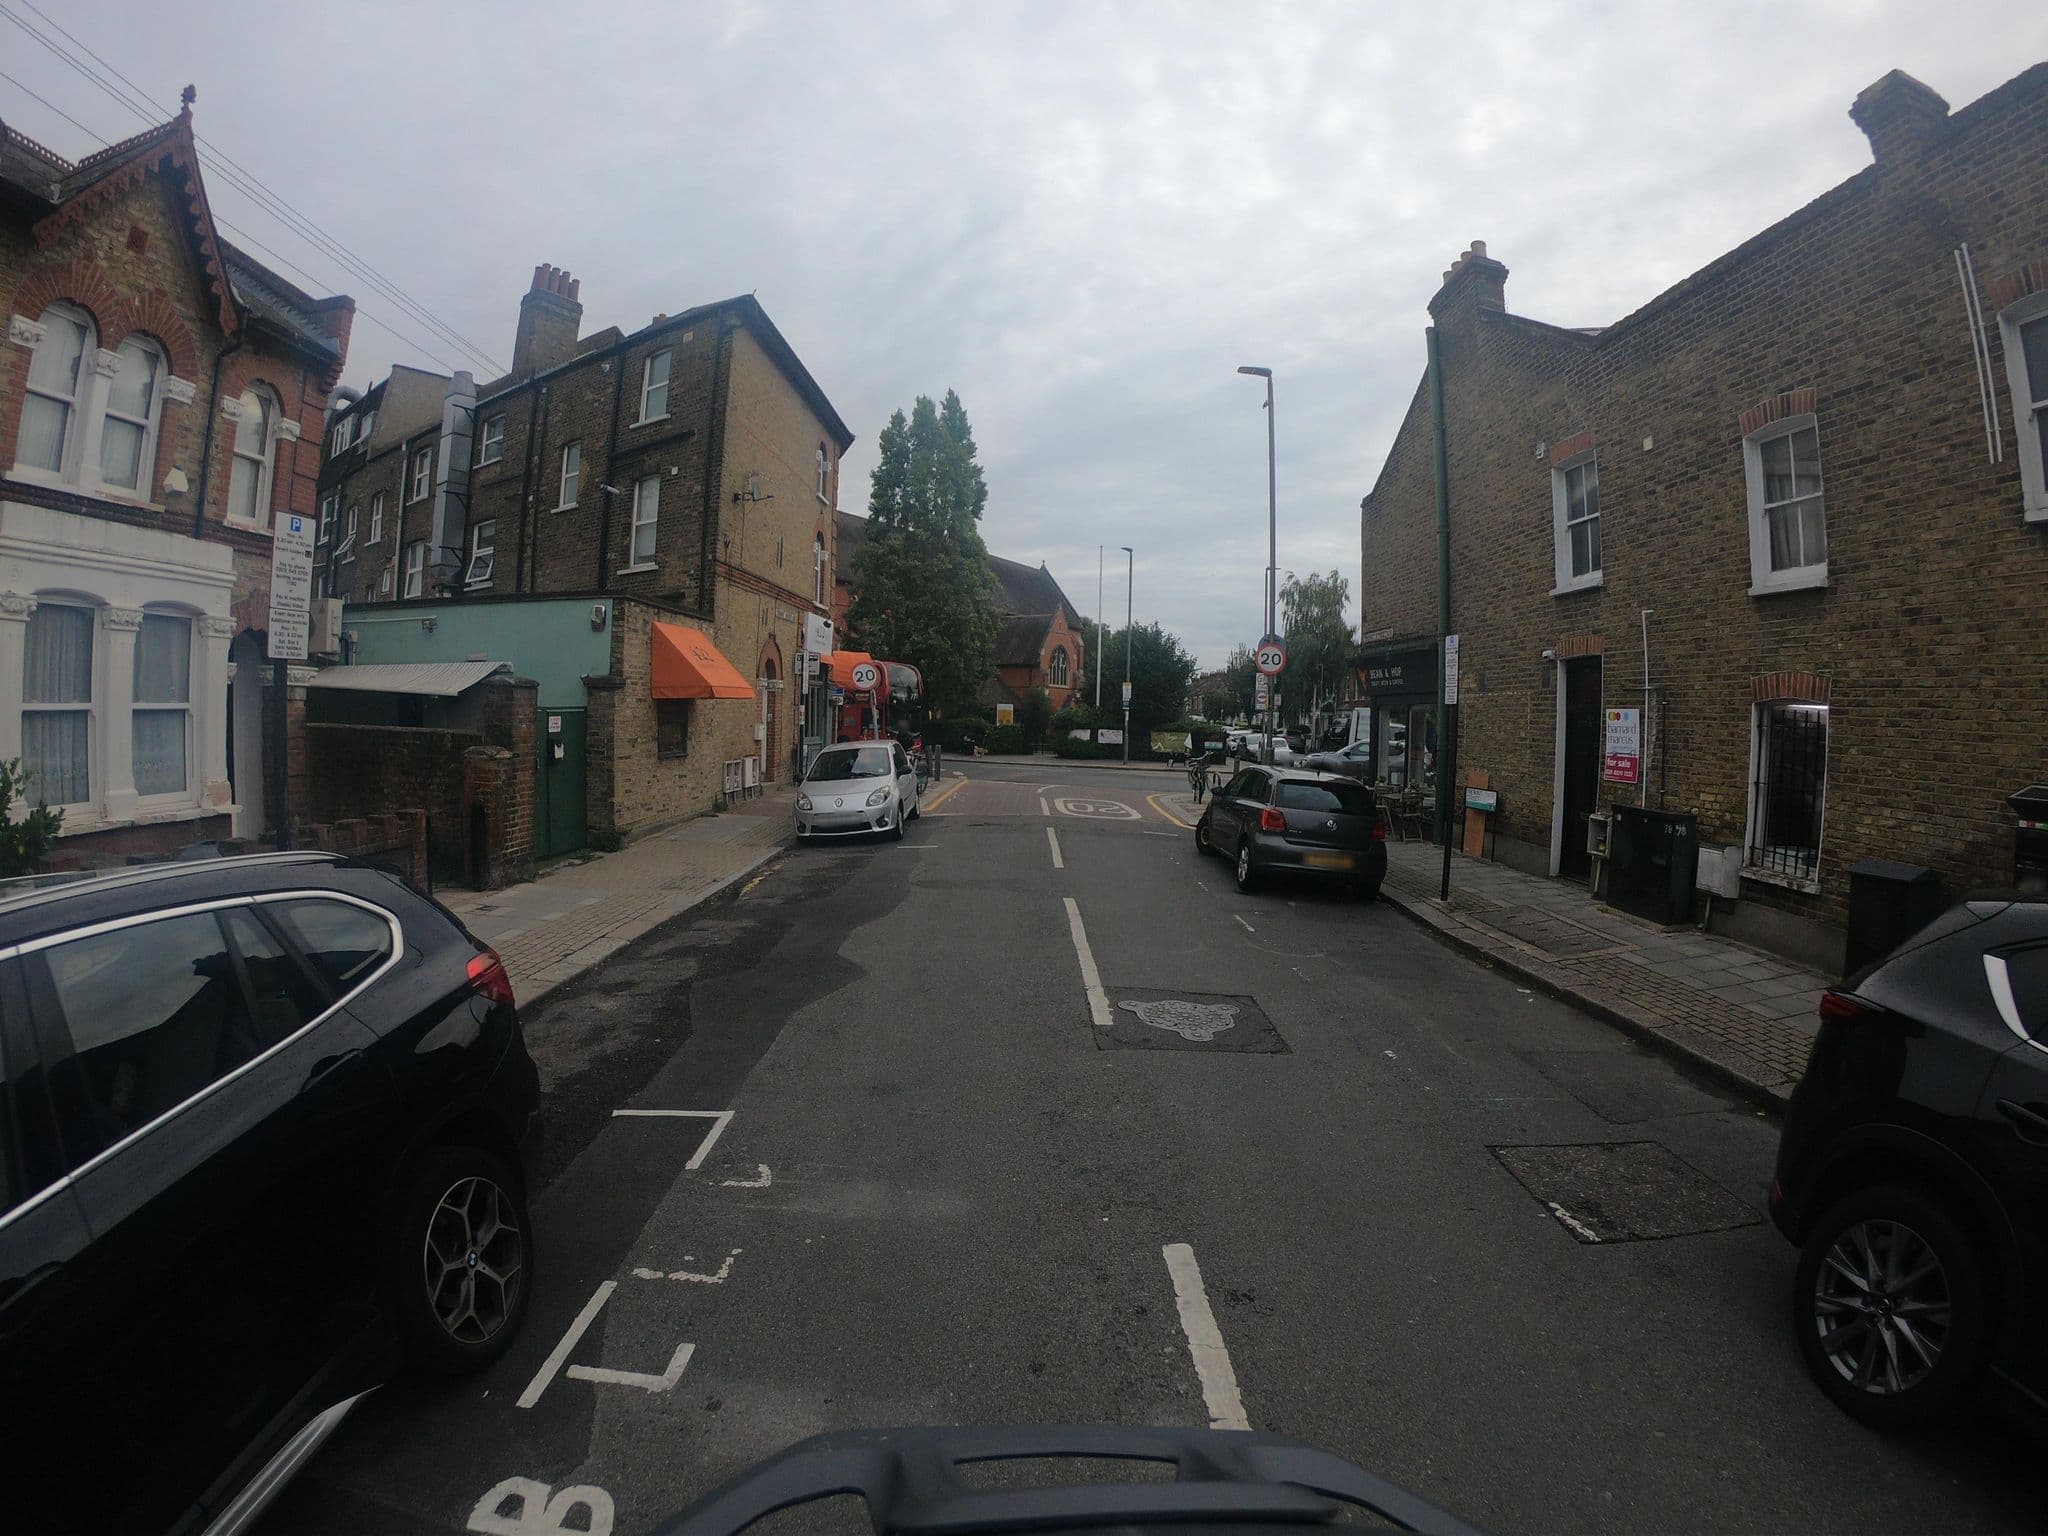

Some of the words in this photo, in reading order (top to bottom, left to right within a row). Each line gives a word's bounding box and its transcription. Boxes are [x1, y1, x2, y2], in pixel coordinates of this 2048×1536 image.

[1261, 653, 1281, 665] 20
[855, 669, 875, 683] 20
[1391, 667, 1402, 677] HOP
[1608, 722, 1637, 735] barnard
[1608, 735, 1634, 744] marcus
[1607, 758, 1617, 767] for
[1617, 759, 1632, 769] sale
